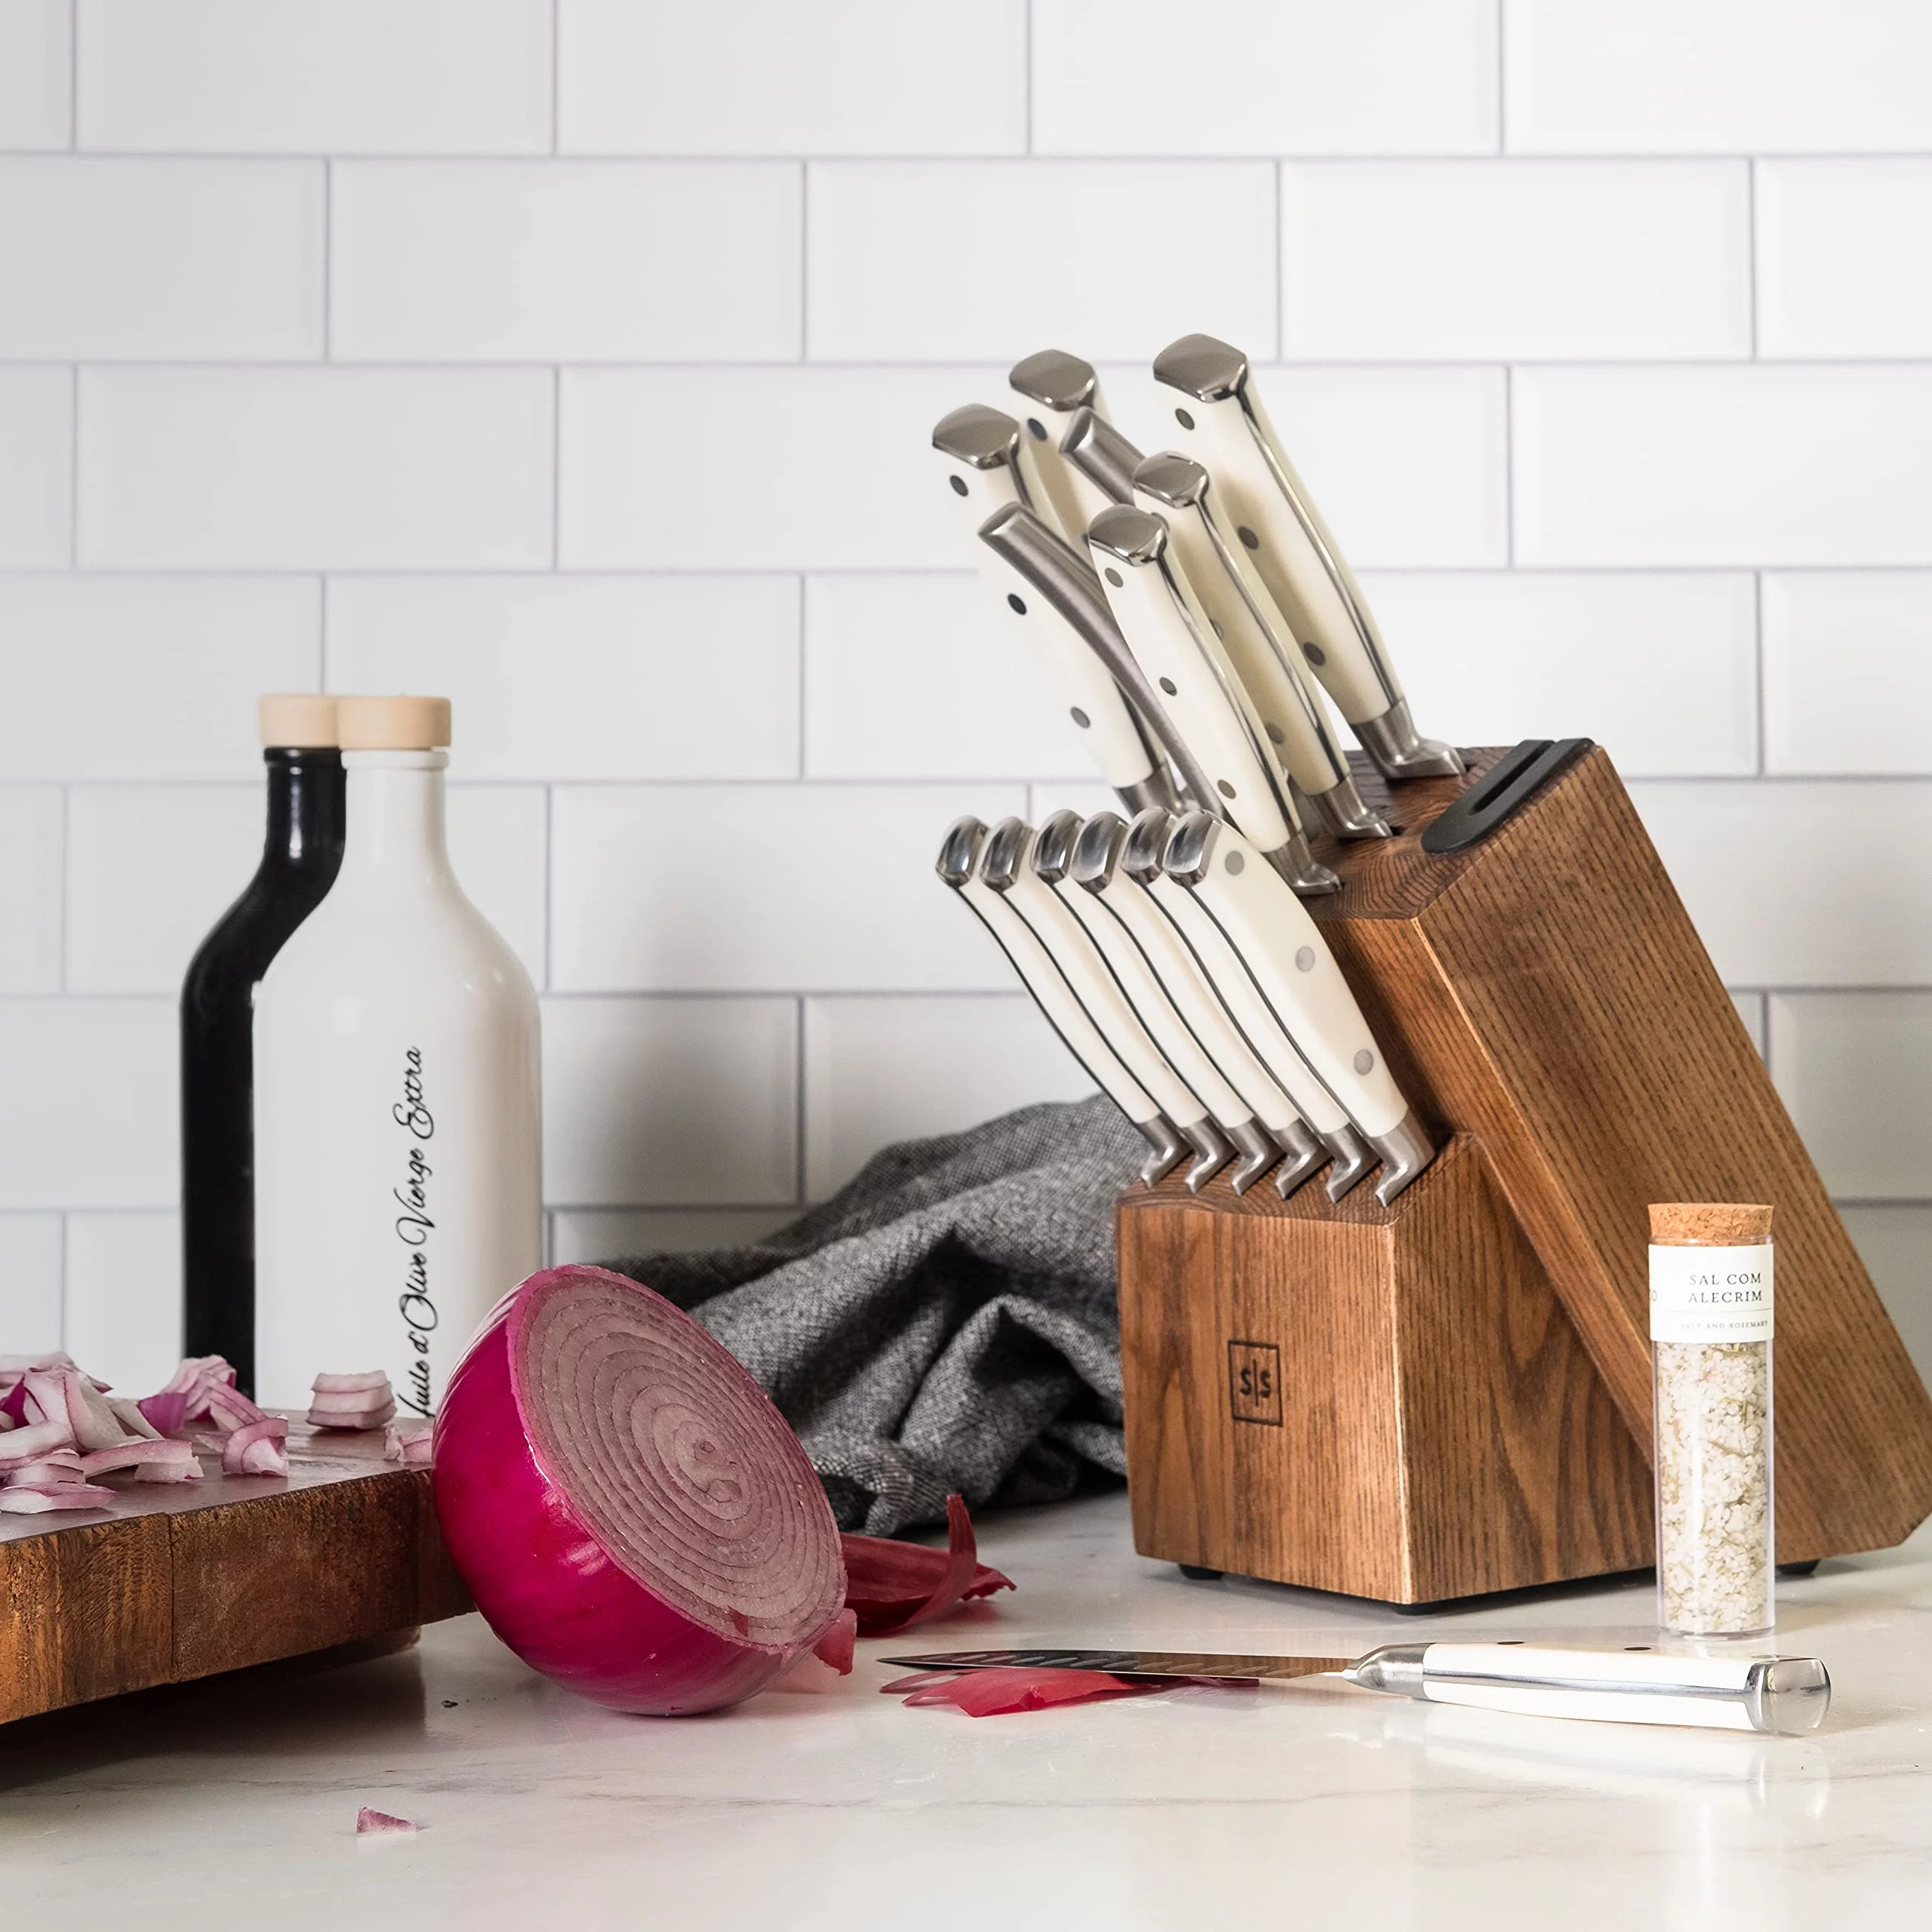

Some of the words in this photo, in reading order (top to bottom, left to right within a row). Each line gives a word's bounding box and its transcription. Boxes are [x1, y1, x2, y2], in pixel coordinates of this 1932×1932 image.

[392, 1045, 434, 1140] Extra
[393, 1148, 435, 1245] Vierge
[1690, 1274, 1720, 1286] SAL
[1727, 1272, 1762, 1284] COM
[1688, 1290, 1763, 1303] ALECRIM
[1706, 1321, 1726, 1330] AND
